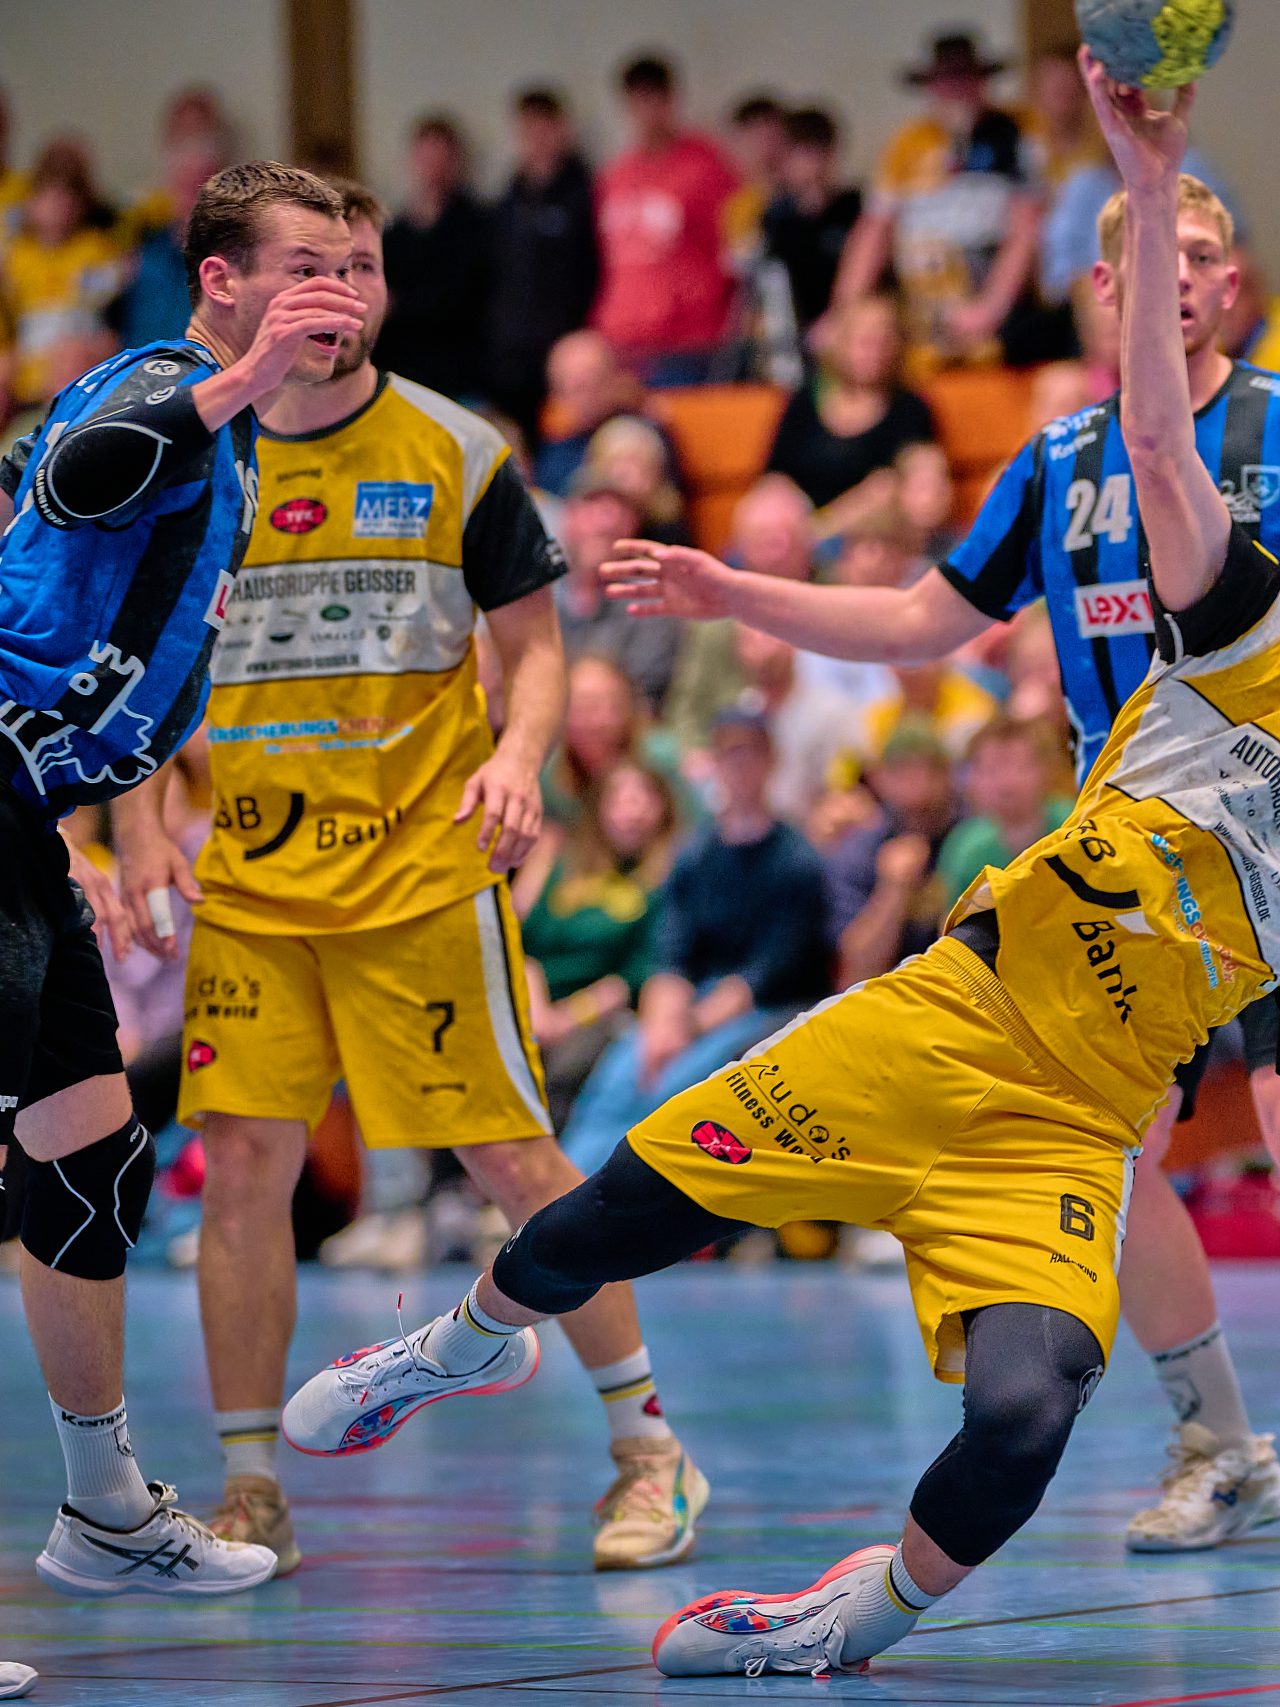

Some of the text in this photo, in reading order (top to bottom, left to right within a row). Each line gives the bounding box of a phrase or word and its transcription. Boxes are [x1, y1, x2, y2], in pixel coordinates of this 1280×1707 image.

[358, 497, 427, 520] MERZ
[1064, 473, 1132, 552] 24
[344, 568, 416, 595] GEISSER
[1072, 920, 1138, 1025] Bank
[206, 1003, 260, 1020] World
[425, 999, 455, 1053] 7
[725, 1071, 775, 1130] Fitness
[1060, 1193, 1095, 1241] 6
